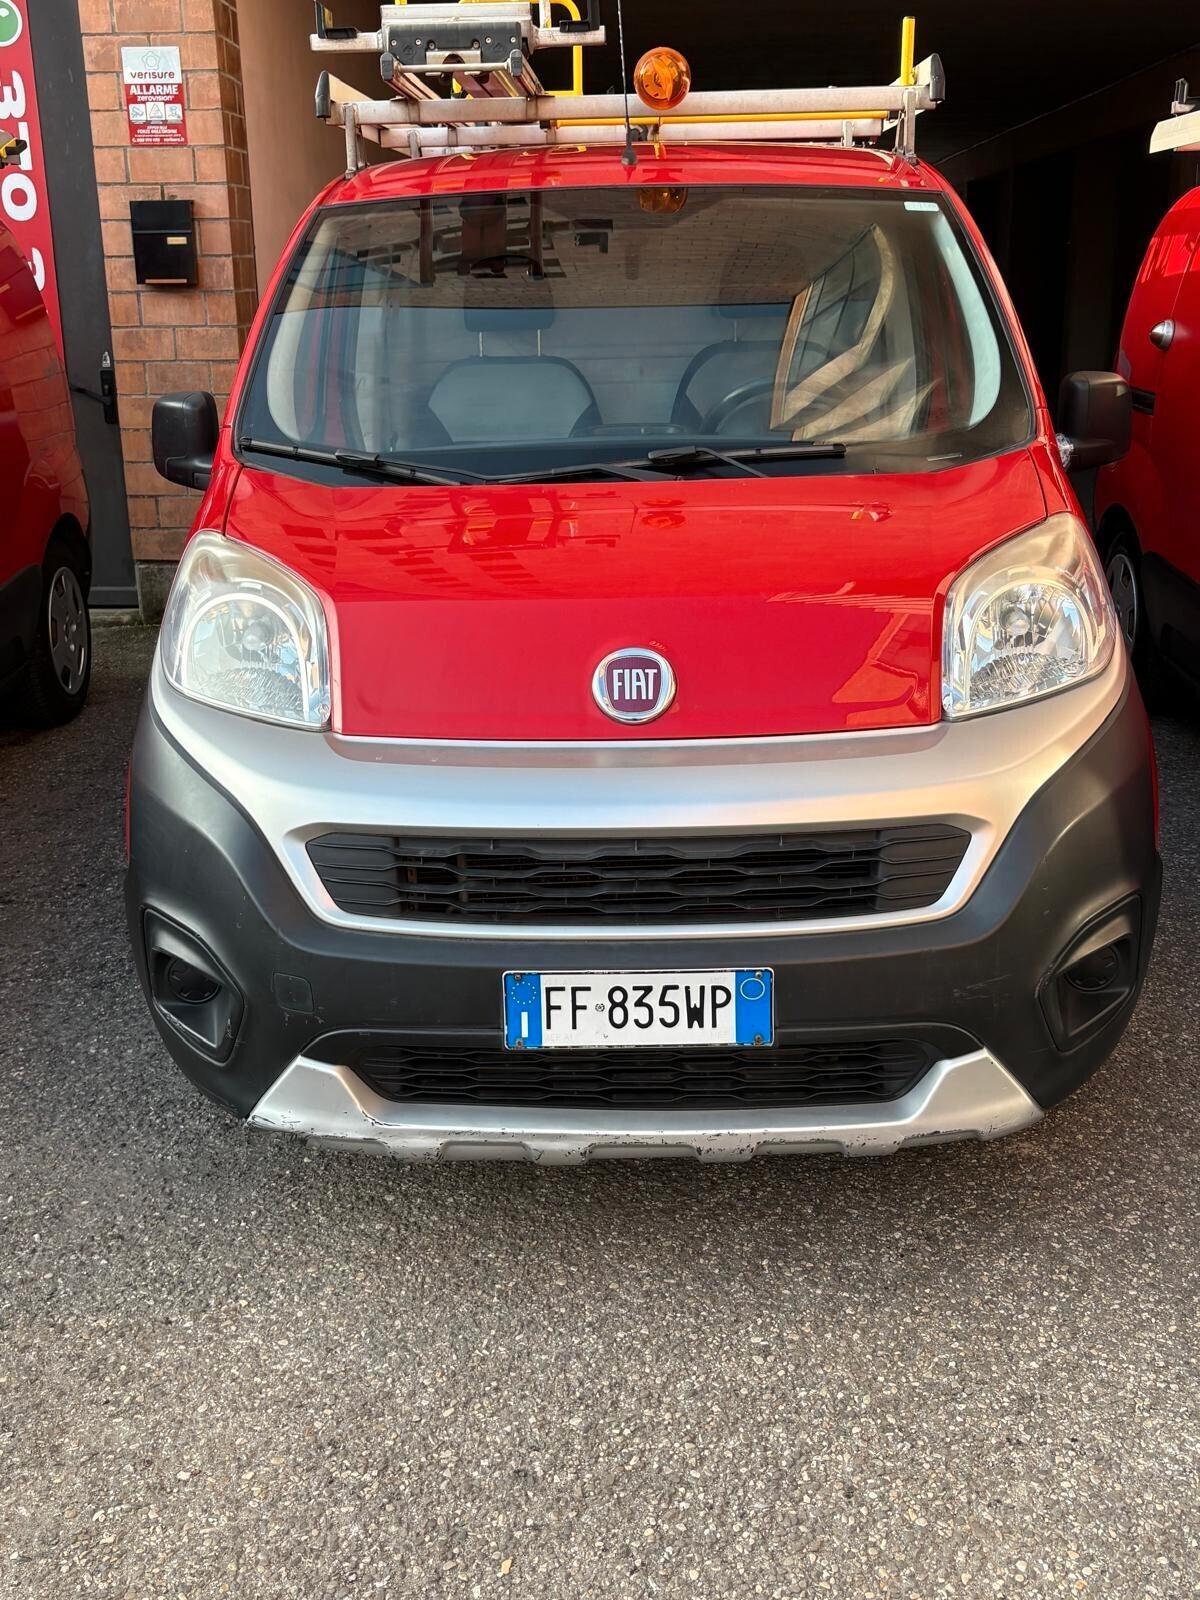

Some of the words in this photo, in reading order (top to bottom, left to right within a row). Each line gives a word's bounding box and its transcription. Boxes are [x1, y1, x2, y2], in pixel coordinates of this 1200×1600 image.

[130, 71, 175, 79] verisure
[130, 85, 179, 95] ALLARME
[612, 668, 658, 701] FIAT
[545, 986, 592, 1030] FF
[607, 984, 732, 1030] 835WP
